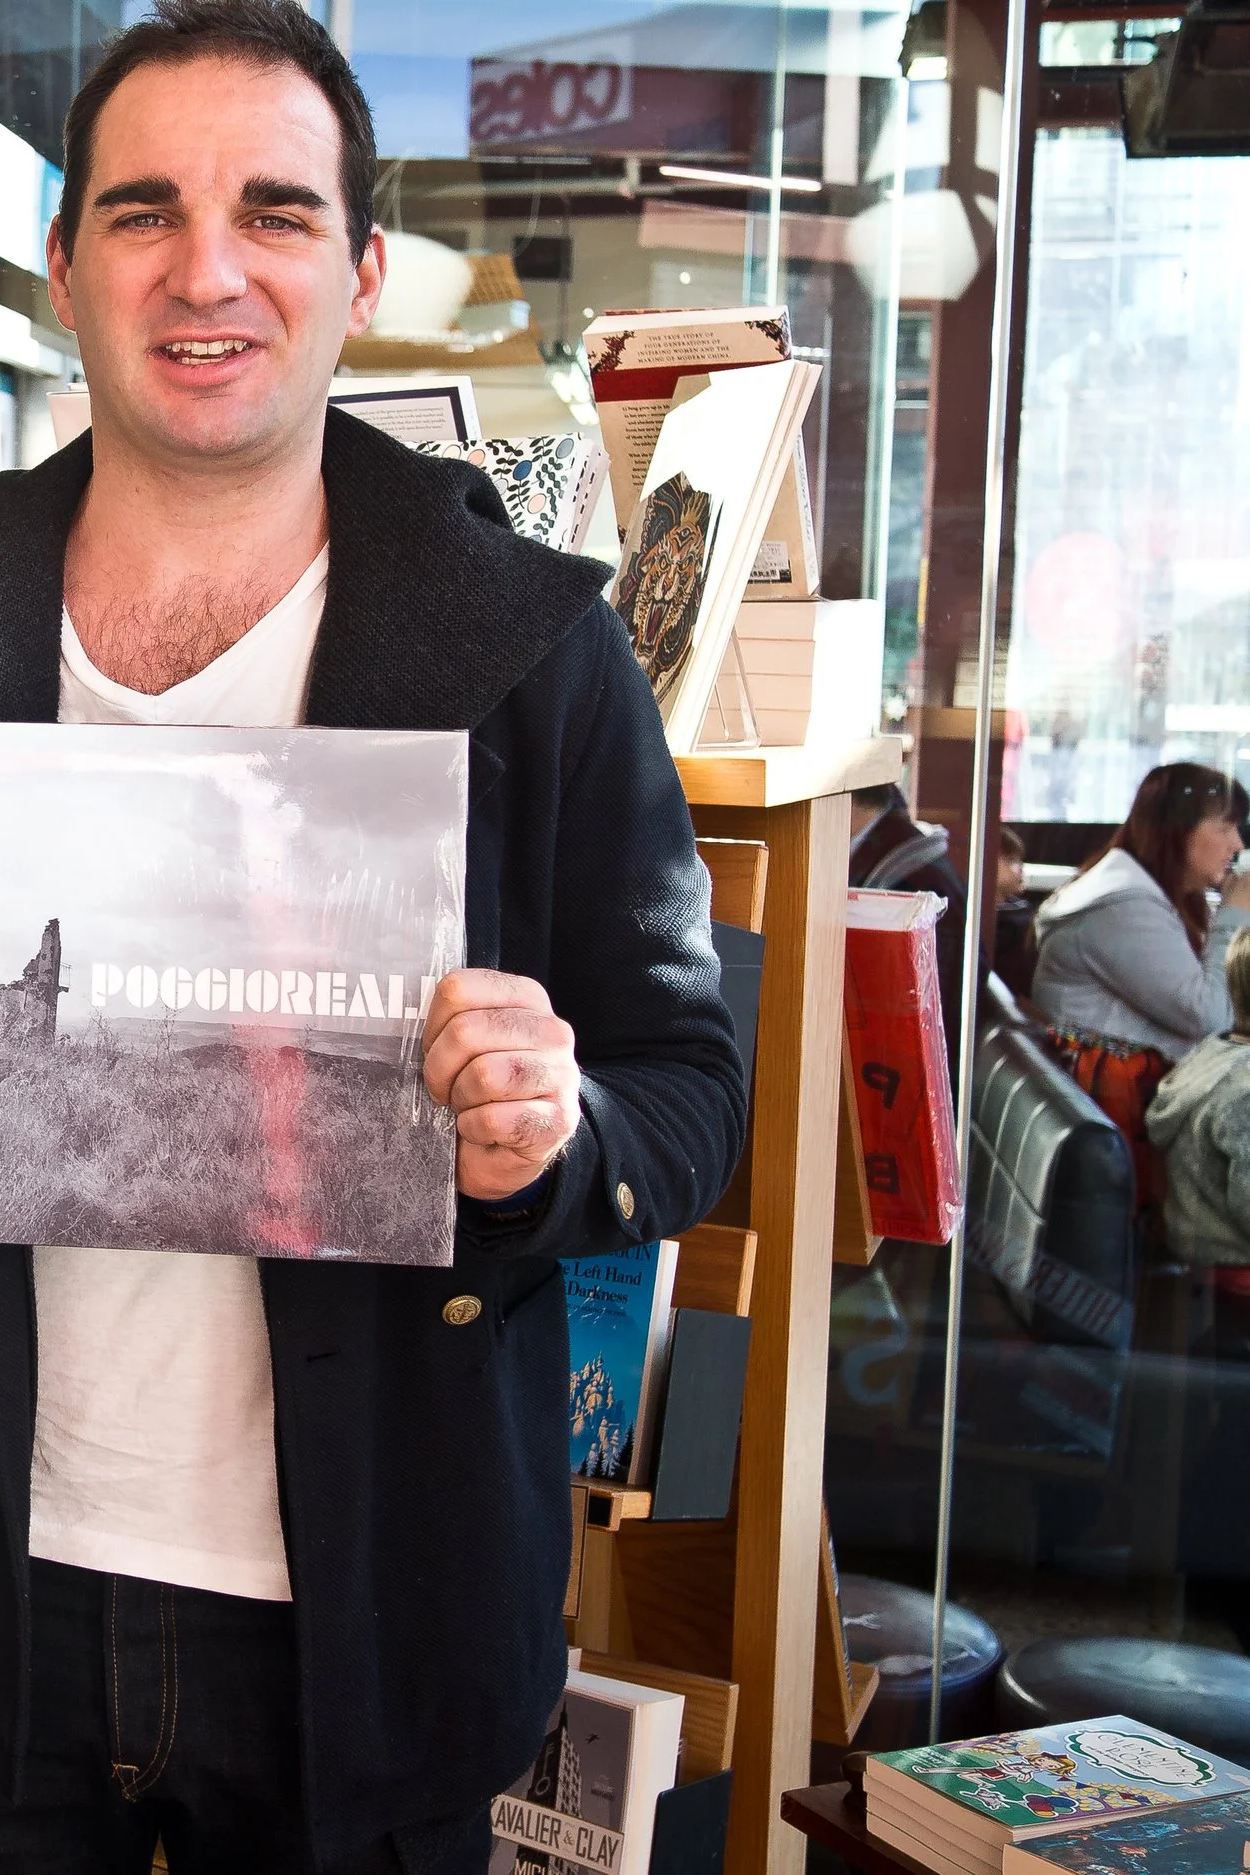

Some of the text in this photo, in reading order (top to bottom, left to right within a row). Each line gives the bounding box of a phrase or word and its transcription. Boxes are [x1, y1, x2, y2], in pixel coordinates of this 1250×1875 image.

[574, 1261, 642, 1286] Left Hand
[568, 1280, 628, 1304] Darkness
[1098, 1734, 1198, 1778] CLEMENTINE
[1105, 1747, 1158, 1769] ROSE
[491, 1797, 620, 1870] AVALIER CLAY
